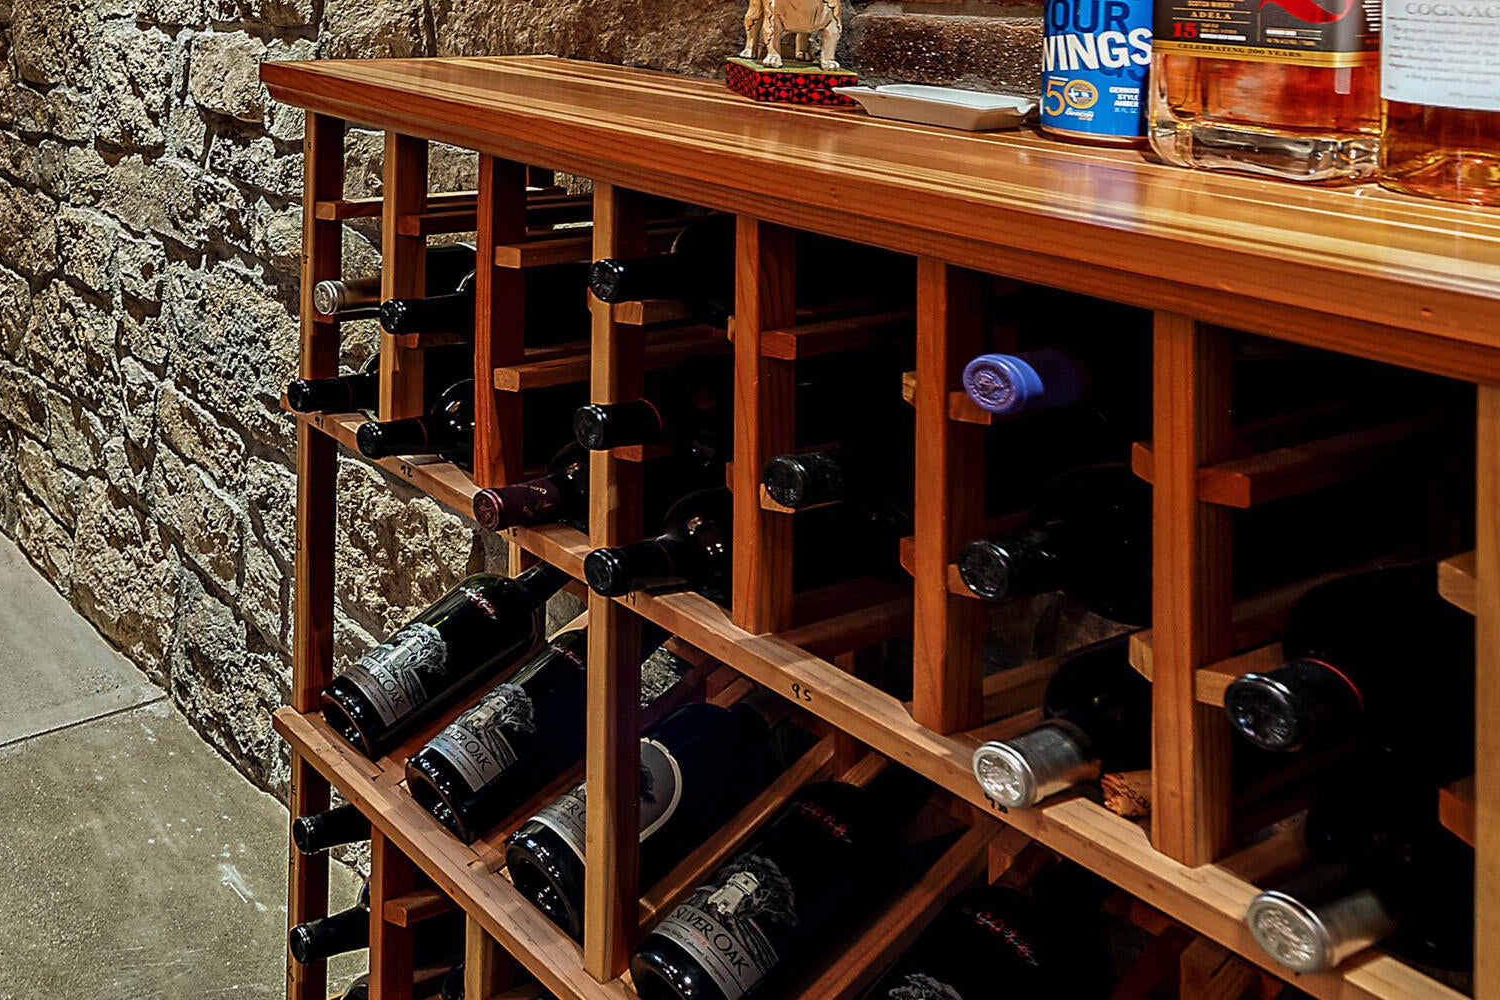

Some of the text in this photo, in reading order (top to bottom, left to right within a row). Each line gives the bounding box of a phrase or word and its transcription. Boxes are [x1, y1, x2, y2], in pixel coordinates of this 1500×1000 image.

[1190, 11, 1232, 20] ADELA
[1173, 22, 1198, 38] 15
[1178, 42, 1244, 54] CELEBRATING
[1268, 50, 1302, 58] YEARS
[1045, 79, 1099, 117] 50
[314, 416, 324, 428] 91
[401, 464, 414, 478] 92
[383, 679, 405, 710] OAK
[791, 682, 812, 702] 95
[465, 740, 493, 773] OAK
[671, 905, 751, 977] SILVER OAK
